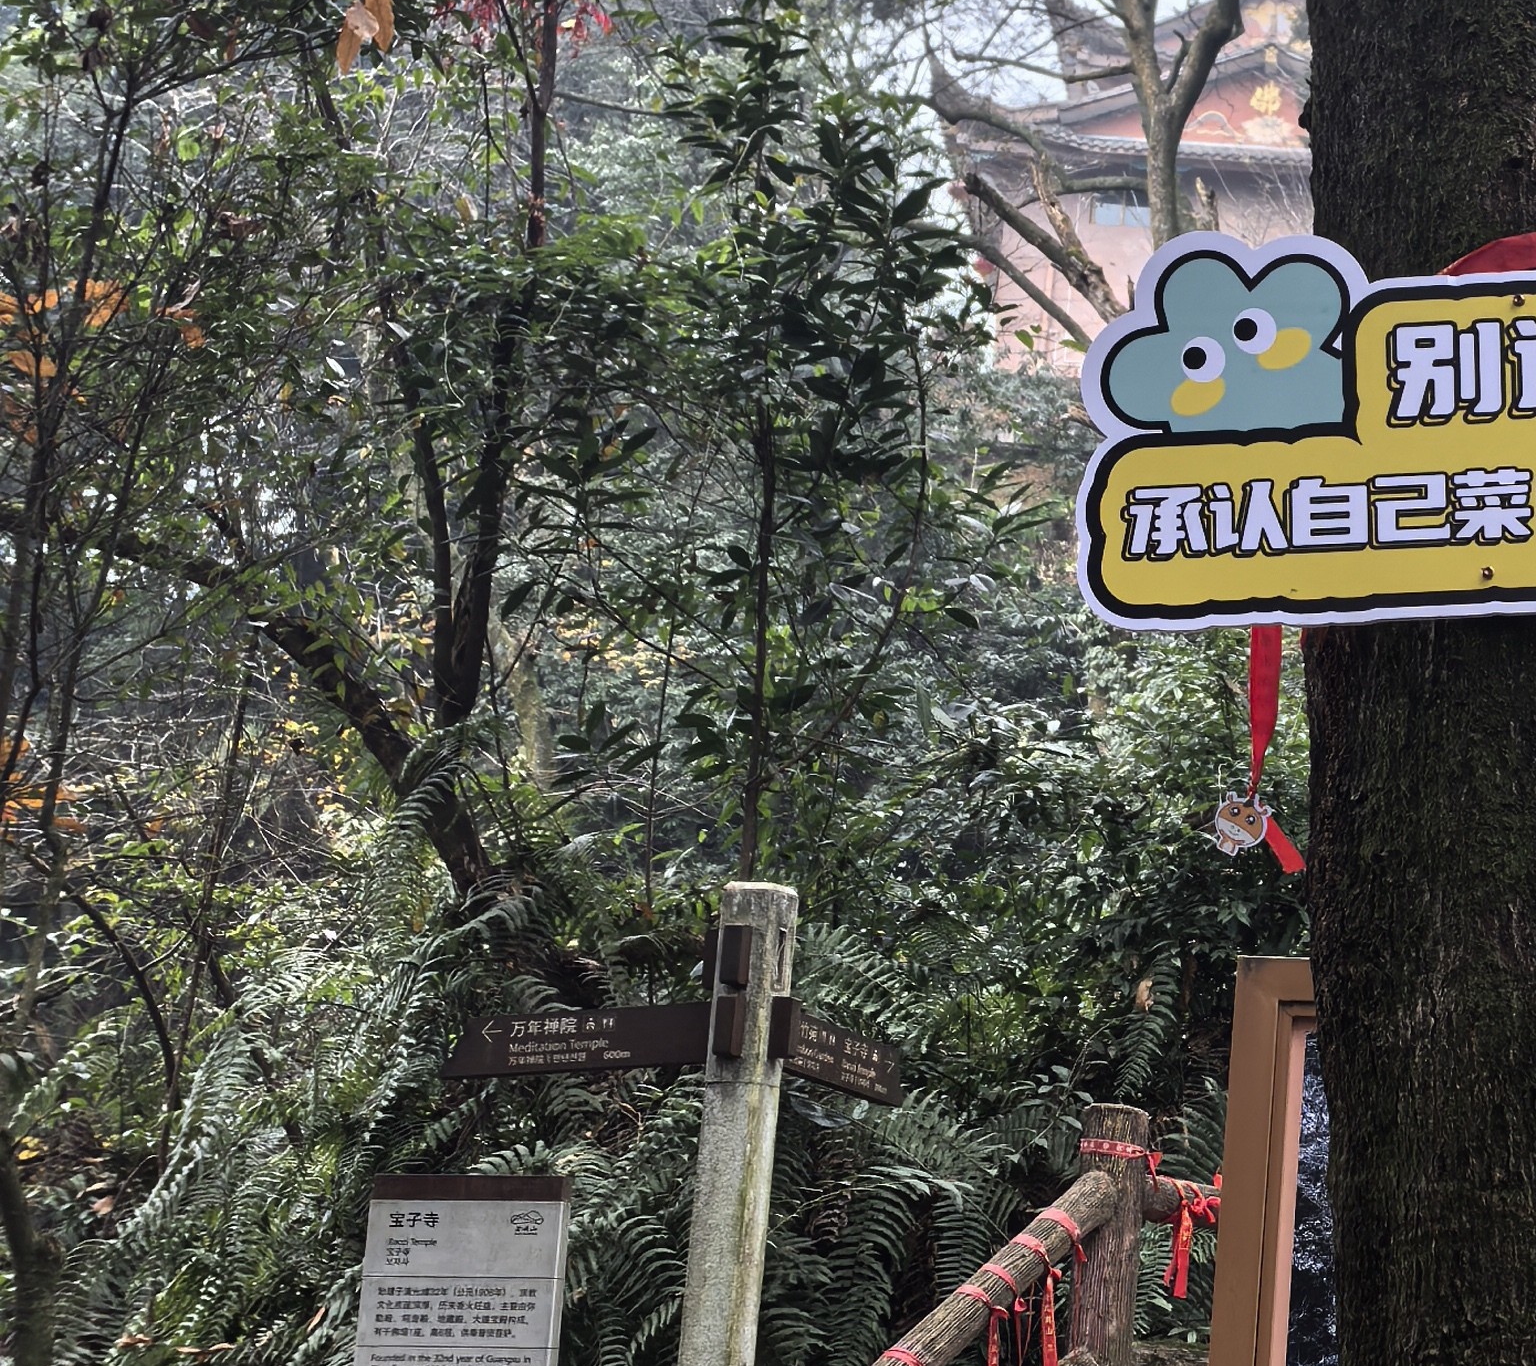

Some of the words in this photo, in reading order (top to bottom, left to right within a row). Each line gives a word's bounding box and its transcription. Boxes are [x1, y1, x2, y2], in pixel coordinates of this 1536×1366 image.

[510, 1017, 577, 1037] 万年禅院
[509, 1040, 567, 1053] Meditation
[569, 1038, 609, 1051] Temple
[389, 1211, 439, 1228] 宝子寺
